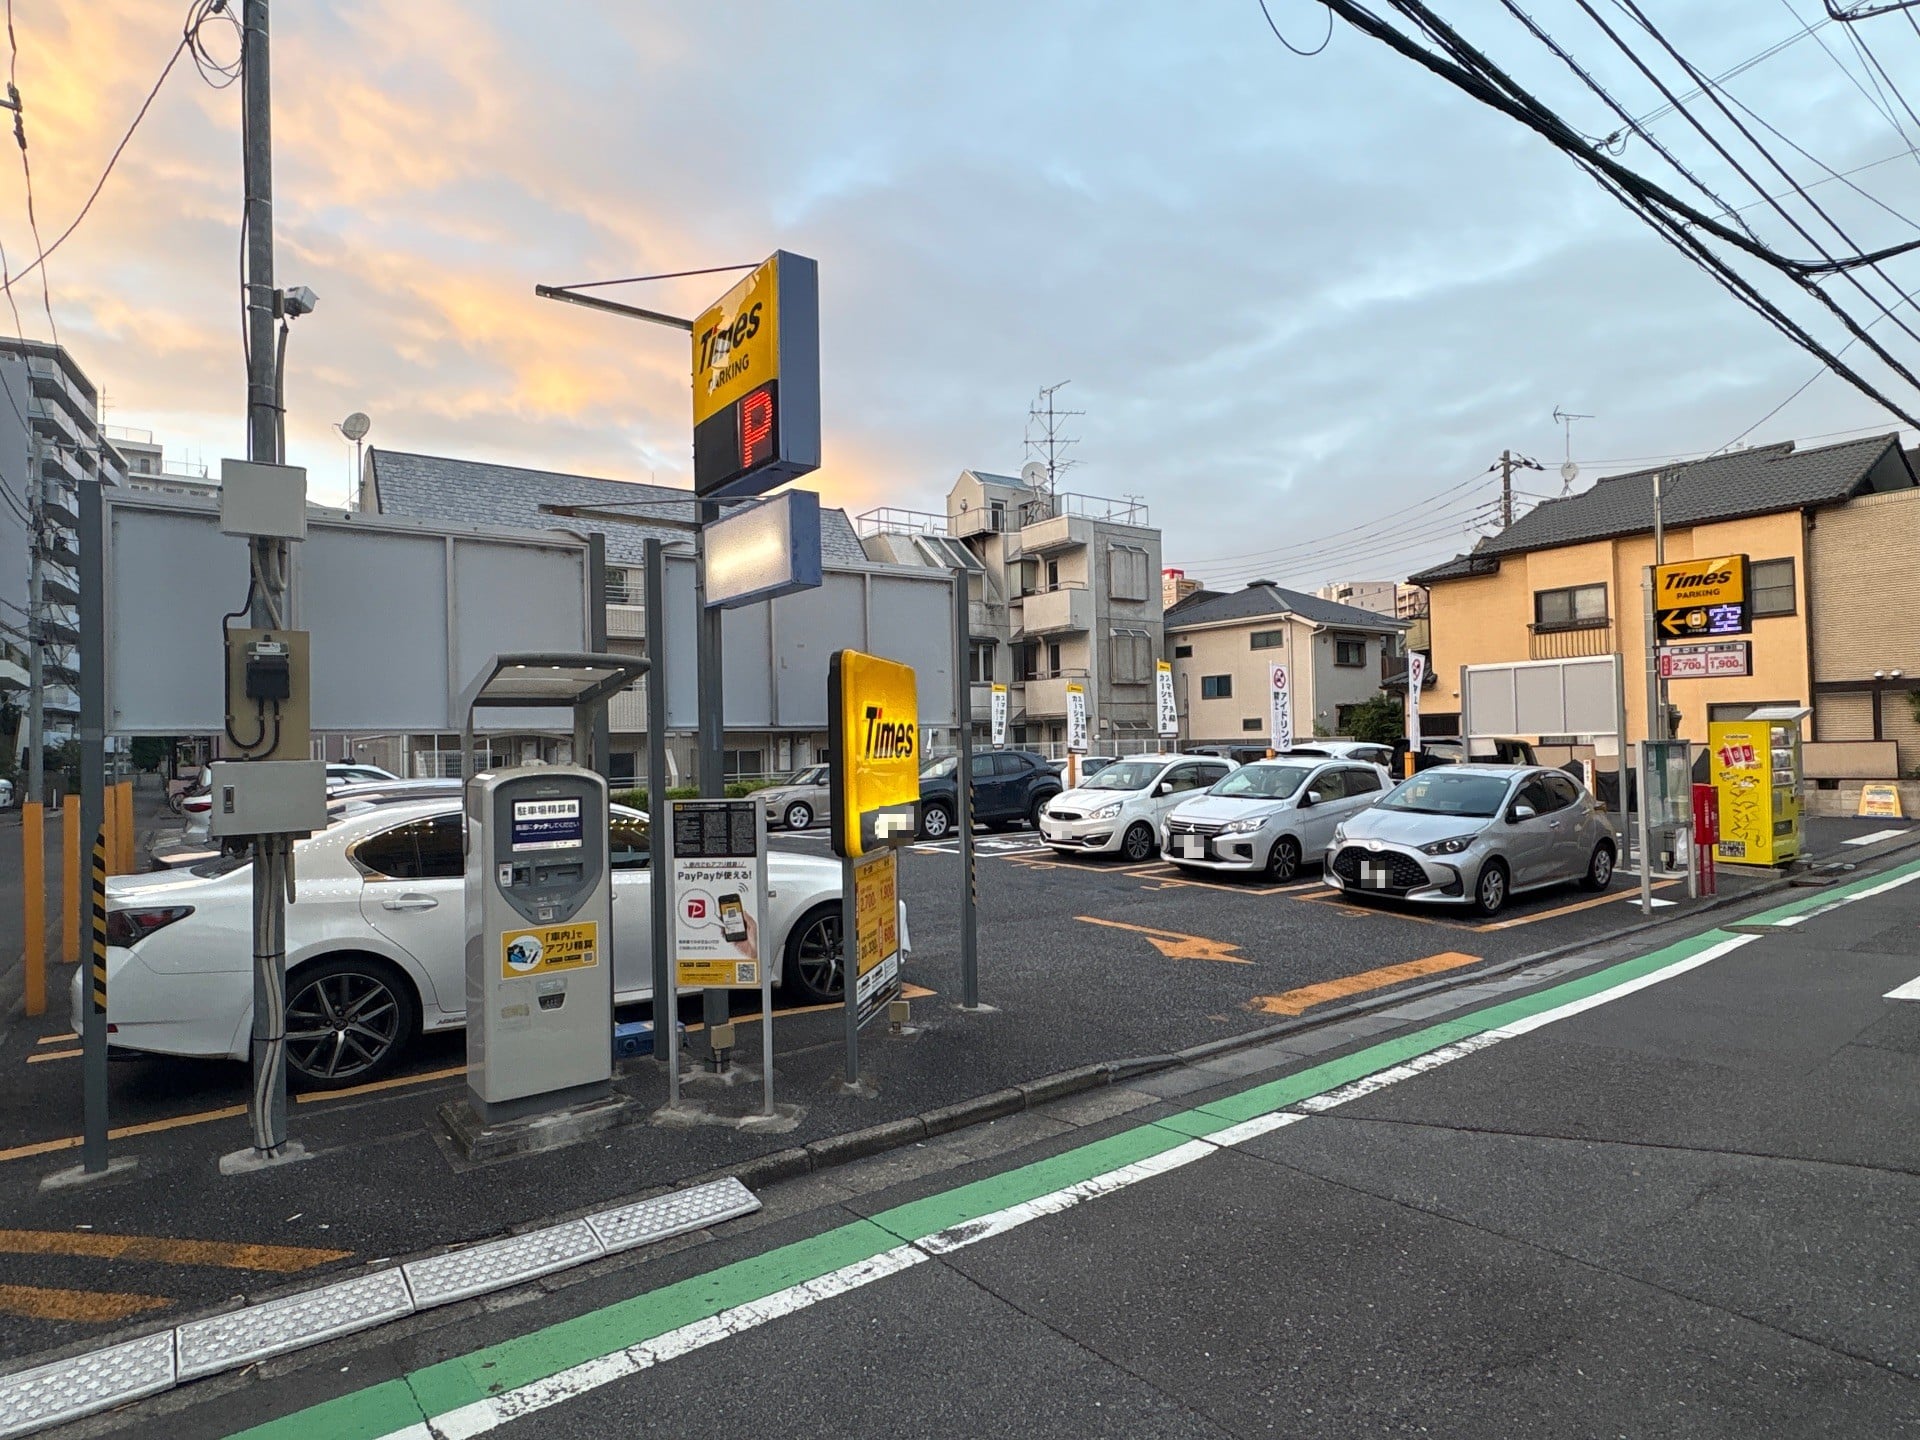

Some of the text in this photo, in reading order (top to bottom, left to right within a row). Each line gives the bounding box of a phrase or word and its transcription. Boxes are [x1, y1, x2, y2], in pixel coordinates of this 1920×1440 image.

[699, 302, 762, 376] Times
[743, 391, 773, 468] P
[1665, 571, 1732, 590] Times
[1676, 588, 1720, 599] PARKING
[1709, 604, 1742, 633] 空
[1280, 692, 1289, 747] アイドリング
[865, 706, 914, 760] Times
[517, 803, 577, 816] 駐車場精算機
[677, 870, 752, 882] PayPayが使える!
[545, 939, 594, 954] アプリ精算
